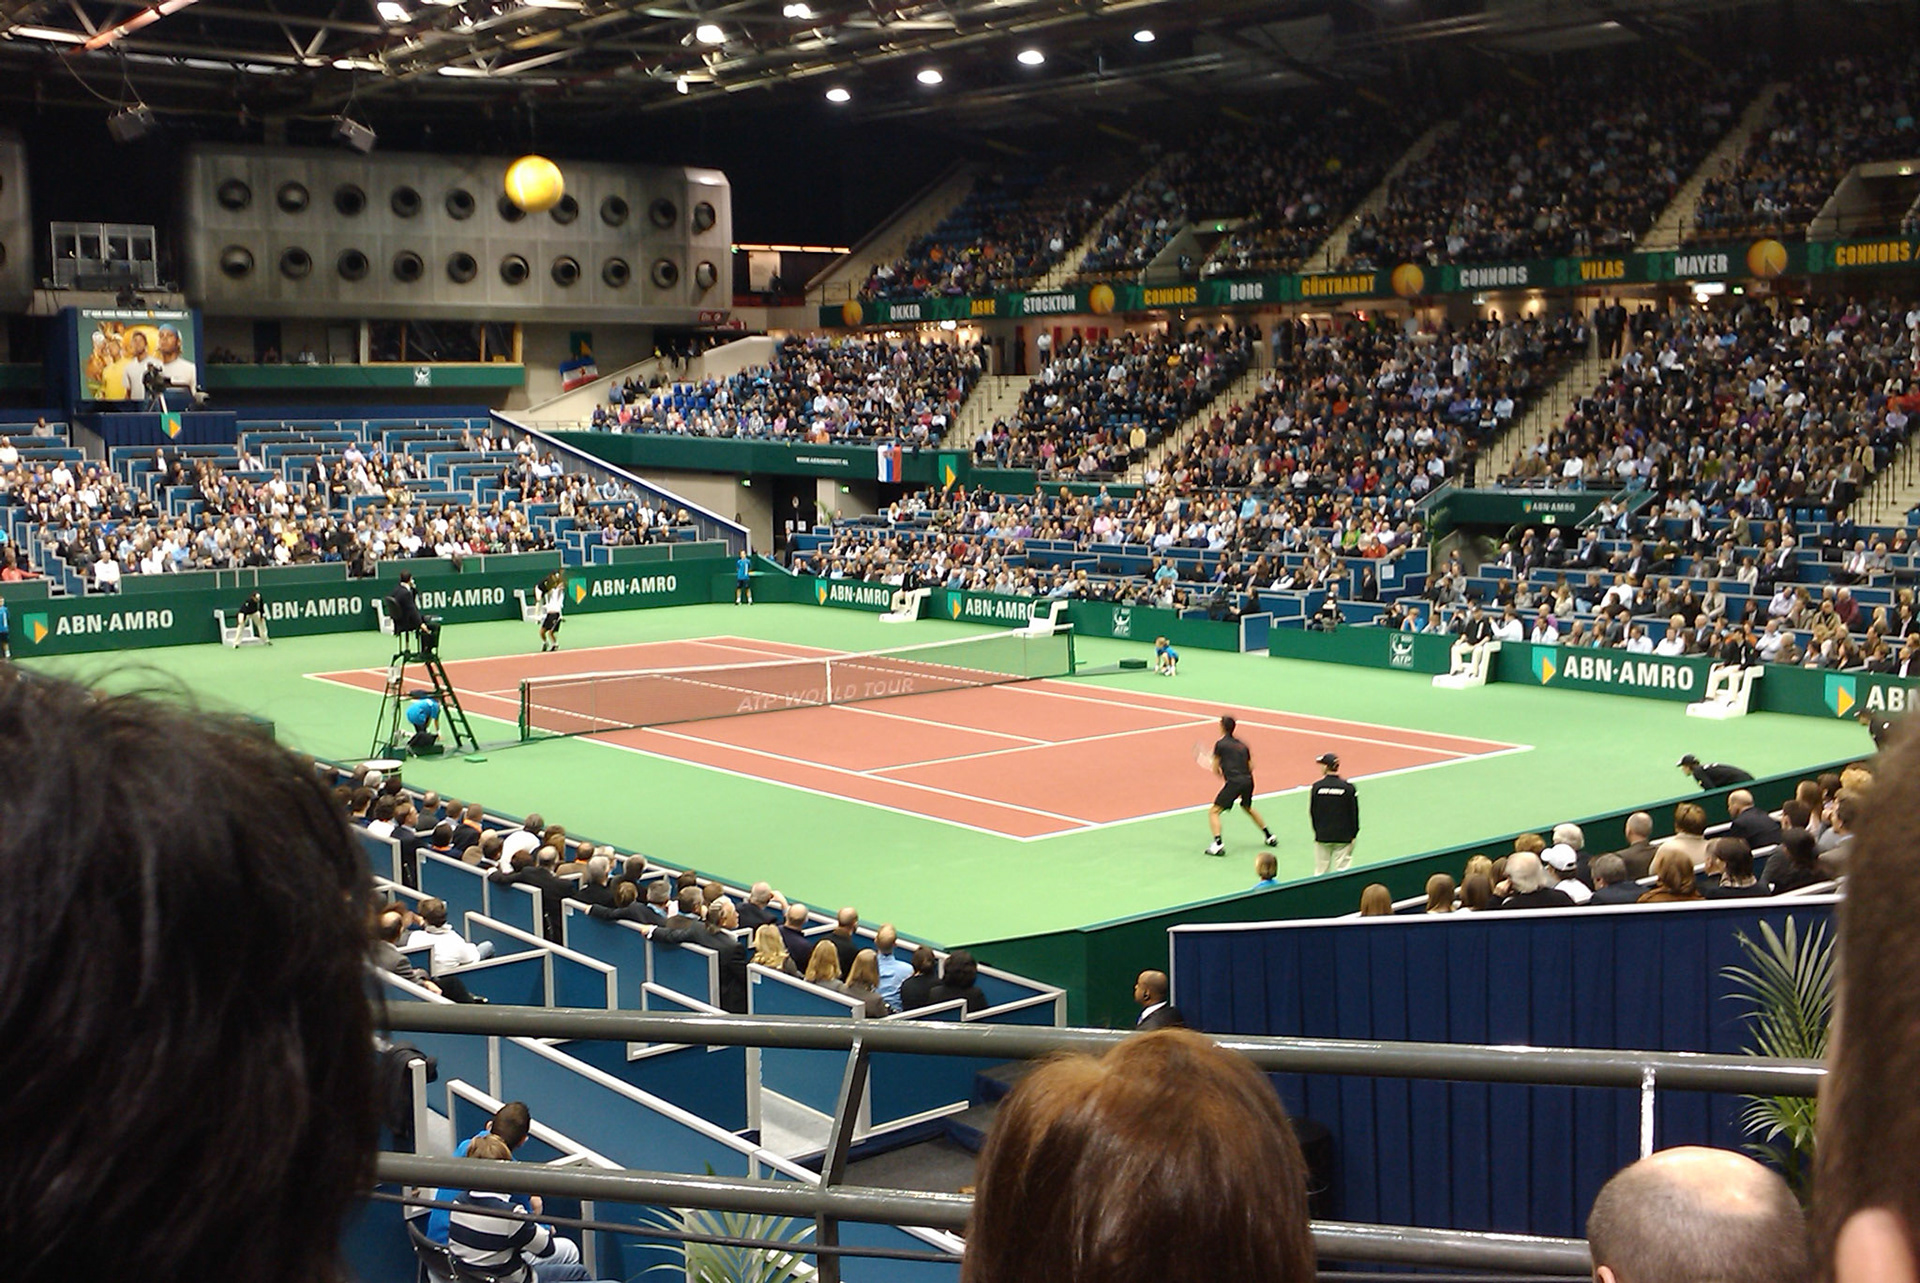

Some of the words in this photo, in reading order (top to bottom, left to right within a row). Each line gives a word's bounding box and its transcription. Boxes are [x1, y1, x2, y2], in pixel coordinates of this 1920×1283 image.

[1835, 241, 1911, 267] CONNORS
[1580, 260, 1625, 281] VILAS
[1674, 254, 1728, 276] MAYER
[1460, 266, 1528, 287] CONNORS
[1143, 287, 1197, 306] CONNORS
[1230, 282, 1263, 301] BORG
[890, 303, 921, 320] OKKER
[1023, 294, 1076, 314] STOCKTON
[737, 696, 777, 713] ATP
[865, 678, 914, 696] TOUR
